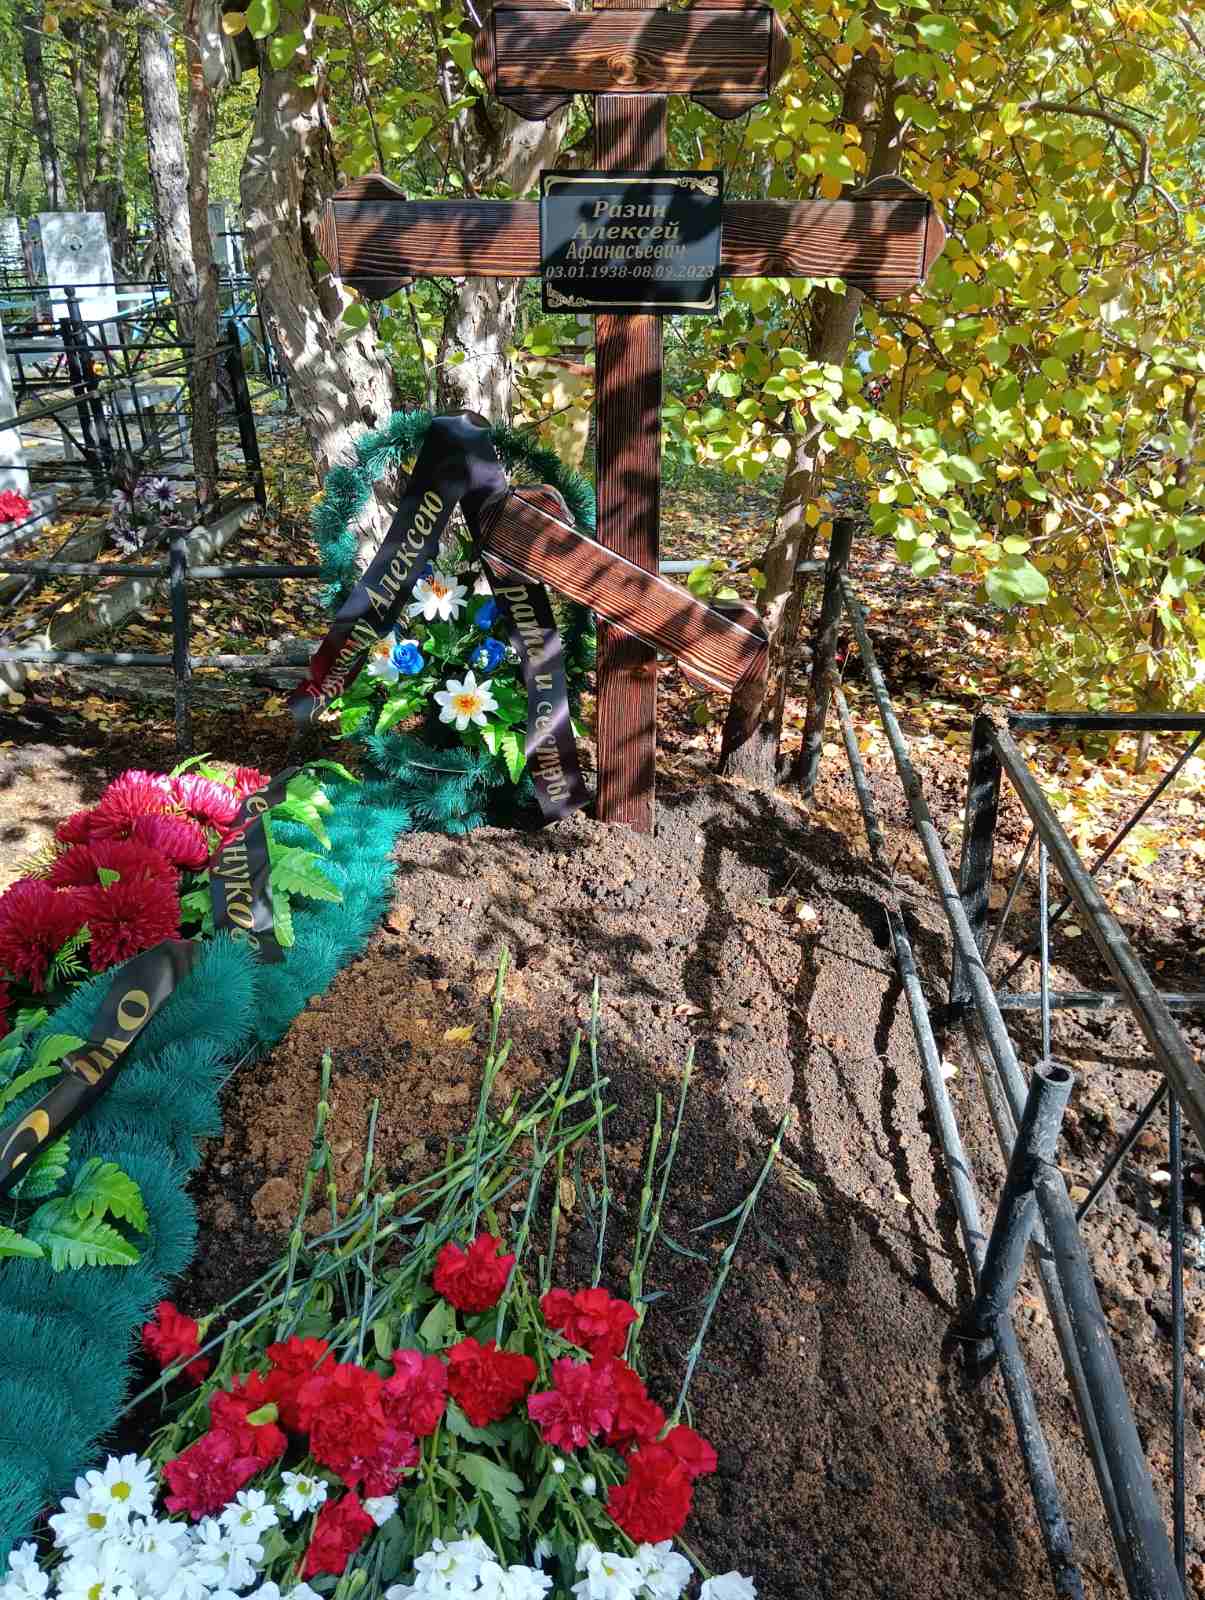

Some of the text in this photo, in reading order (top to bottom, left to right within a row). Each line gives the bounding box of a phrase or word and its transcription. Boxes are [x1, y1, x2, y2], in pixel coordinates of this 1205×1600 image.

[592, 200, 667, 218] Разин
[573, 221, 681, 240] Алексей
[565, 241, 688, 264] Афанасьевич
[545, 265, 715, 279] 03.01.1938-08.09.2023
[365, 490, 444, 621] Алексею
[495, 585, 572, 803] рата и сестры
